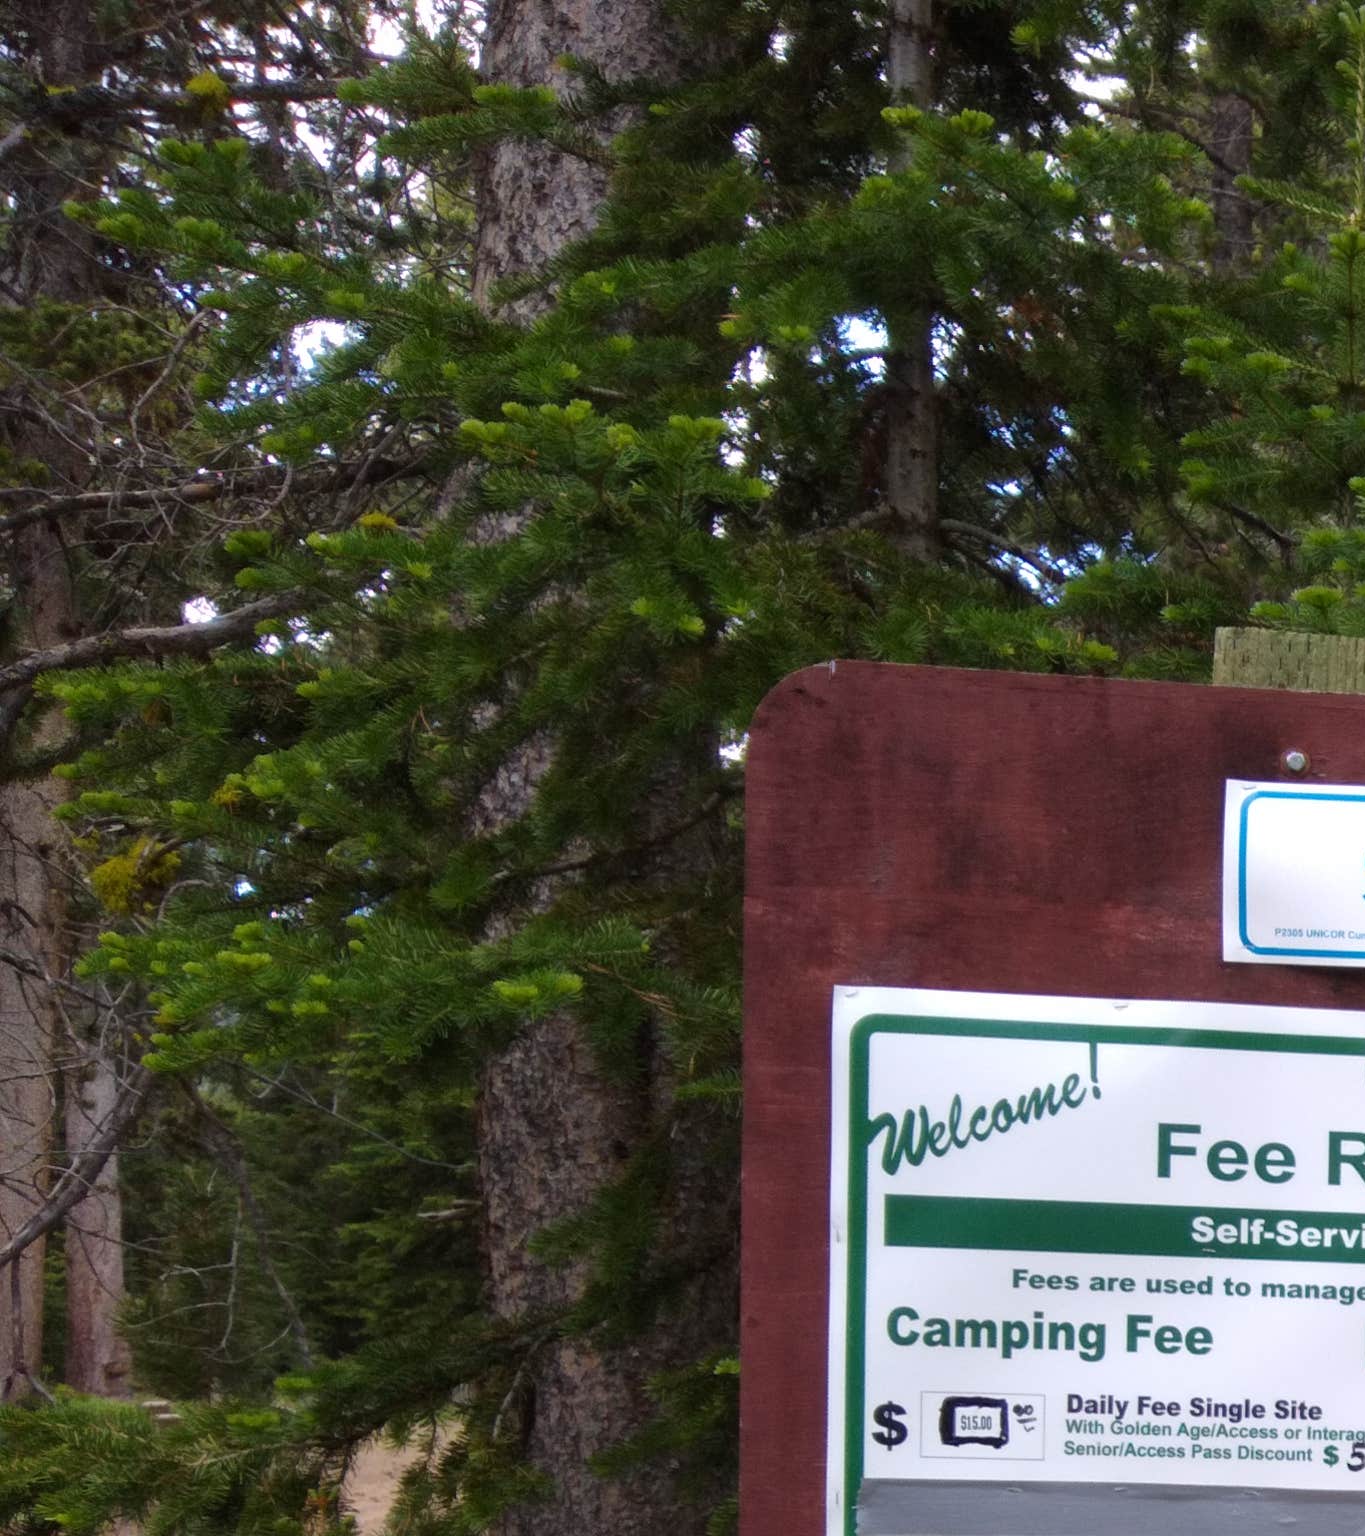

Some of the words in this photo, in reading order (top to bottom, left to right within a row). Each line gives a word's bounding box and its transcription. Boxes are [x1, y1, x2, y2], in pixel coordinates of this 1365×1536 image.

[869, 1043, 1101, 1176] Welcome!
[1157, 1123, 1295, 1183] Fee
[1012, 1269, 1079, 1290] Fees
[1089, 1277, 1135, 1292] are
[1146, 1276, 1212, 1294] used
[1223, 1278, 1250, 1296] to
[887, 1308, 1105, 1361] Camping
[1126, 1315, 1212, 1354] Fee
[1067, 1394, 1128, 1420] Daily
[1137, 1396, 1180, 1416] Fee
[1189, 1398, 1265, 1422] Single
[1274, 1400, 1322, 1420] Site
[872, 1402, 907, 1450] $
[961, 1415, 991, 1430] $15.00
[1065, 1419, 1104, 1434] With
[1110, 1418, 1171, 1435] Golden
[1176, 1422, 1278, 1440] Age/Access
[1284, 1428, 1301, 1439] or
[1064, 1441, 1185, 1457] Senior/Access
[1191, 1444, 1231, 1459] Pass
[1238, 1445, 1312, 1461] Discount
